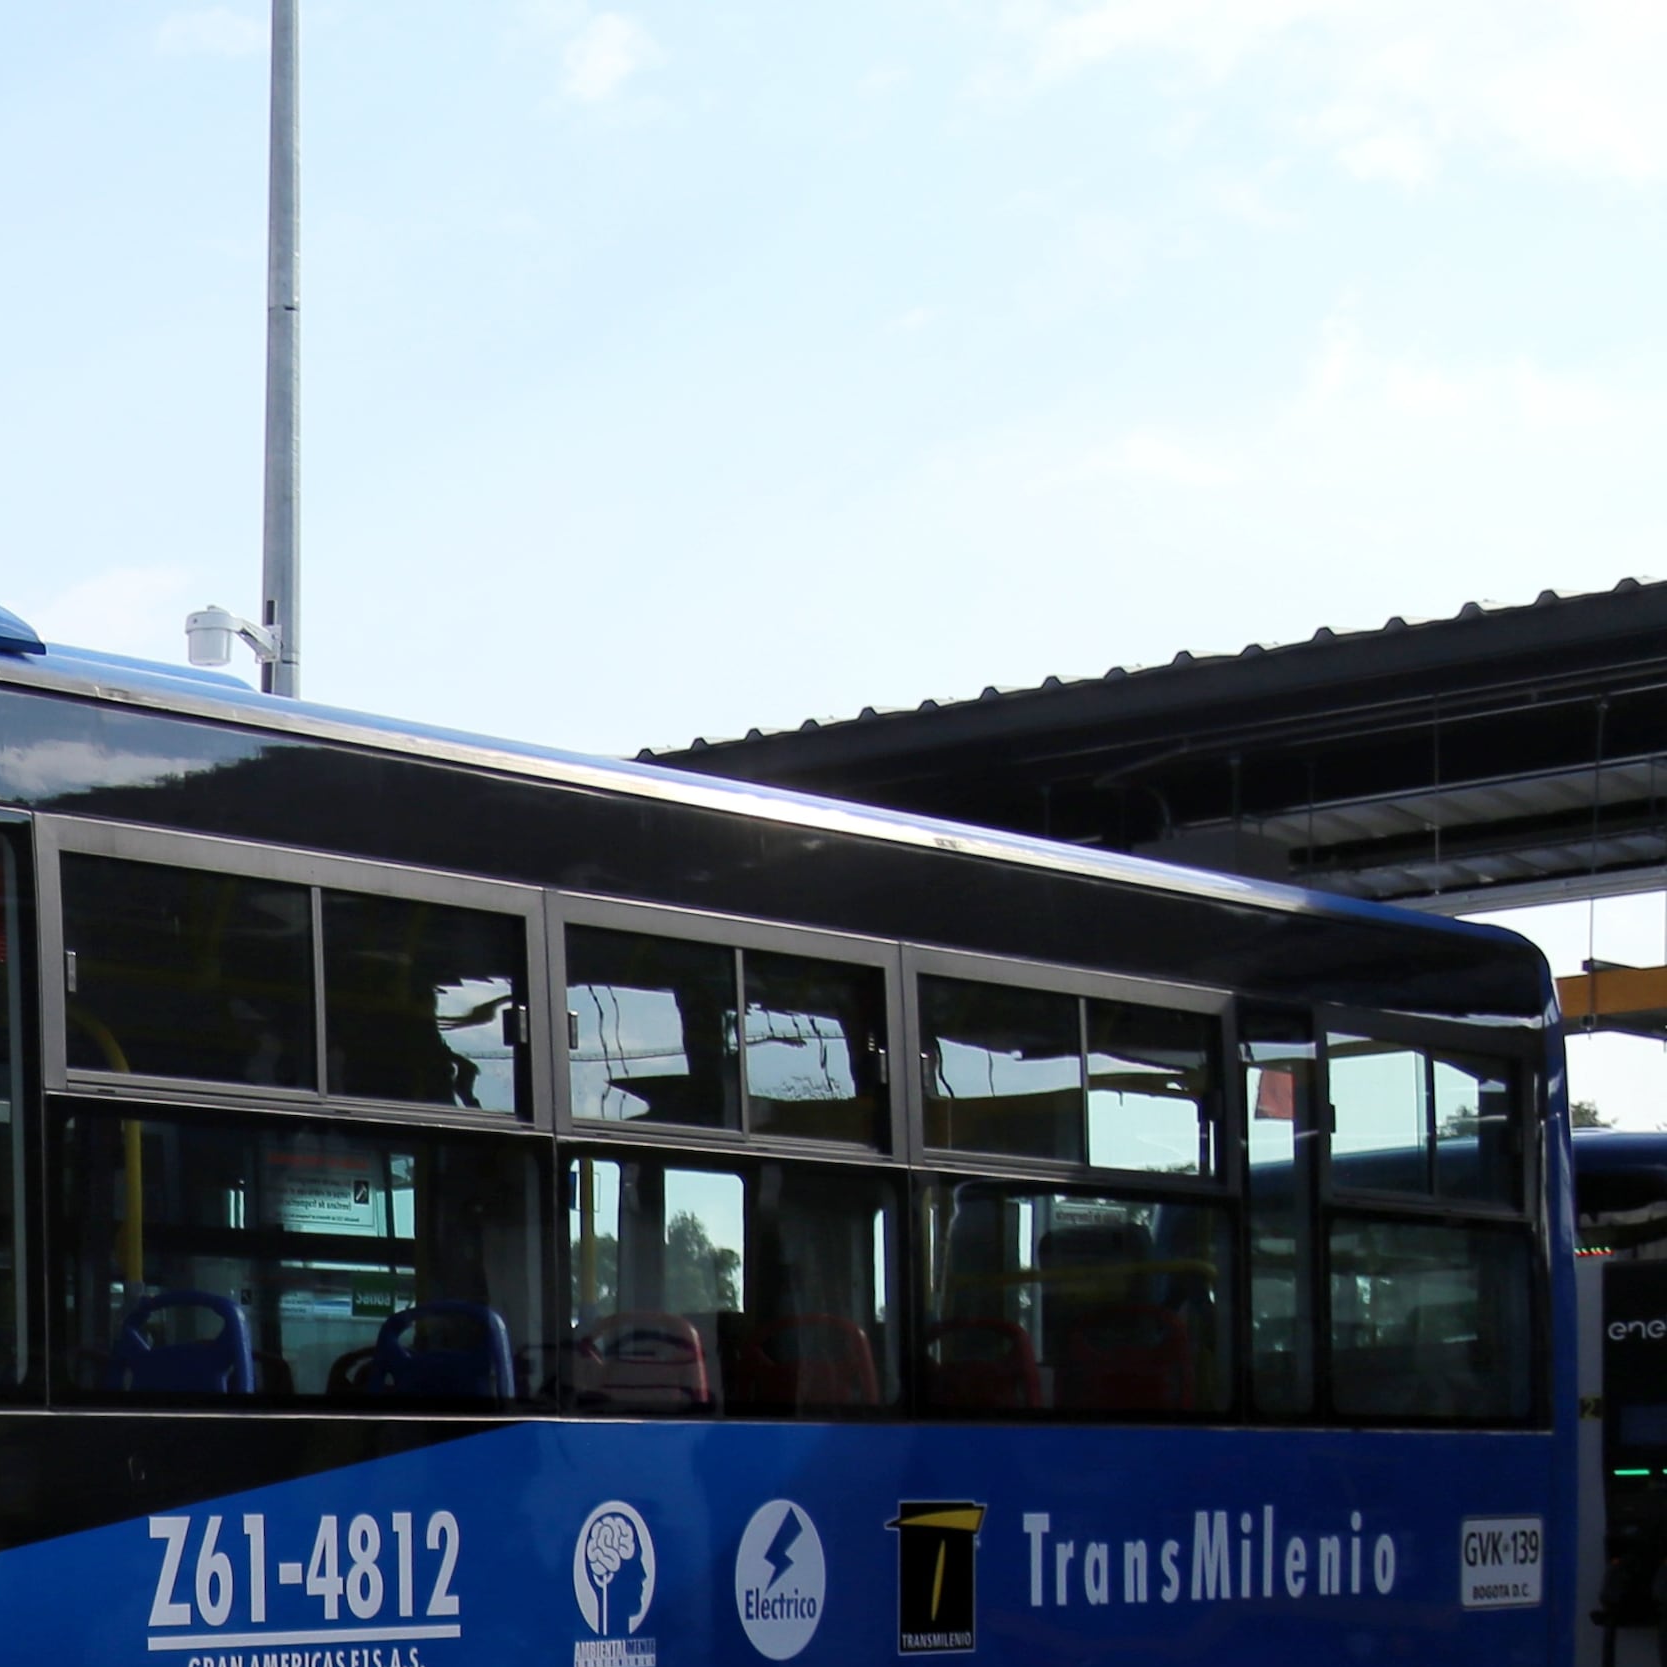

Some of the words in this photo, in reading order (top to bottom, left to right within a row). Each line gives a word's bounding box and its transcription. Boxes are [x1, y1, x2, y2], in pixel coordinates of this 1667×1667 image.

[1608, 1319, 1667, 1341] ene
[148, 1511, 460, 1627] Z61-4812
[1023, 1505, 1396, 1607] TransMilenio
[902, 1632, 971, 1650] TRANSMILENIO
